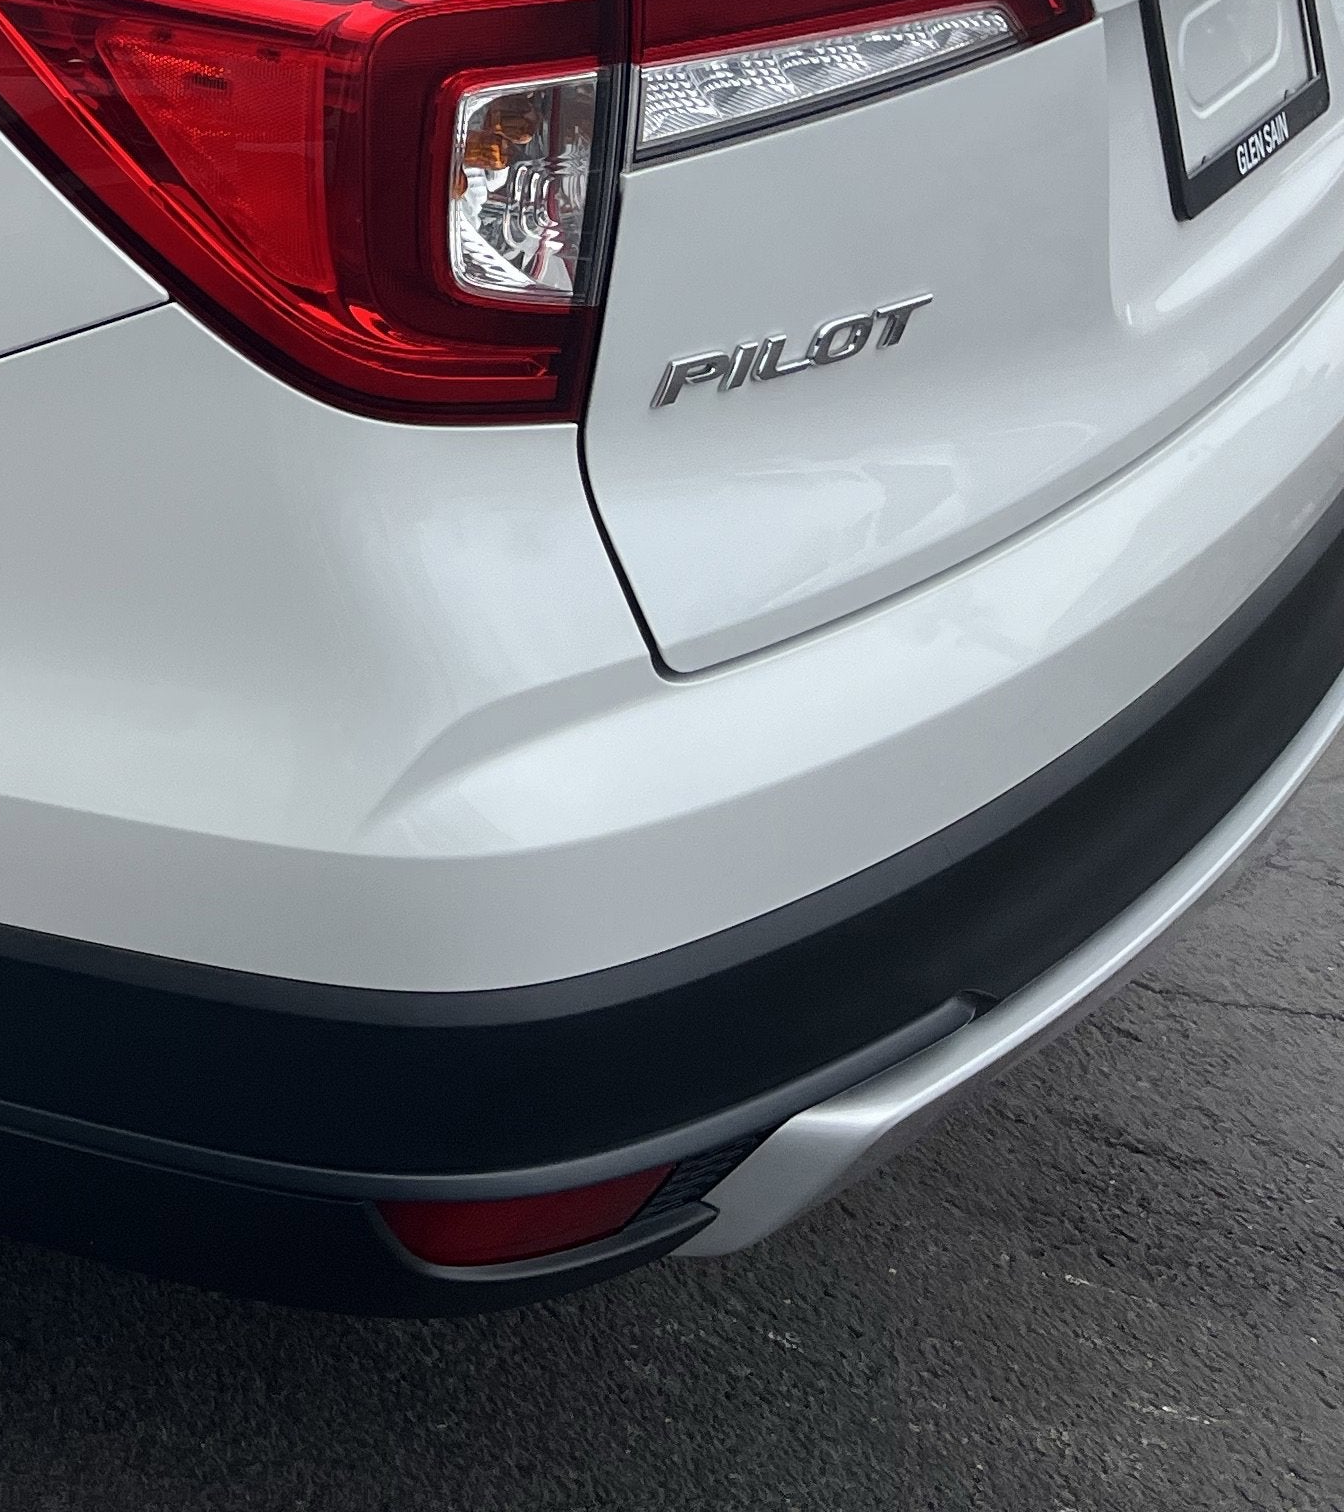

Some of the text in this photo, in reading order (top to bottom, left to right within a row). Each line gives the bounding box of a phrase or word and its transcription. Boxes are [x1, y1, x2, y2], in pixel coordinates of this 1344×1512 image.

[1236, 111, 1289, 175] GLEN SAIN
[649, 292, 935, 409] PILOT
